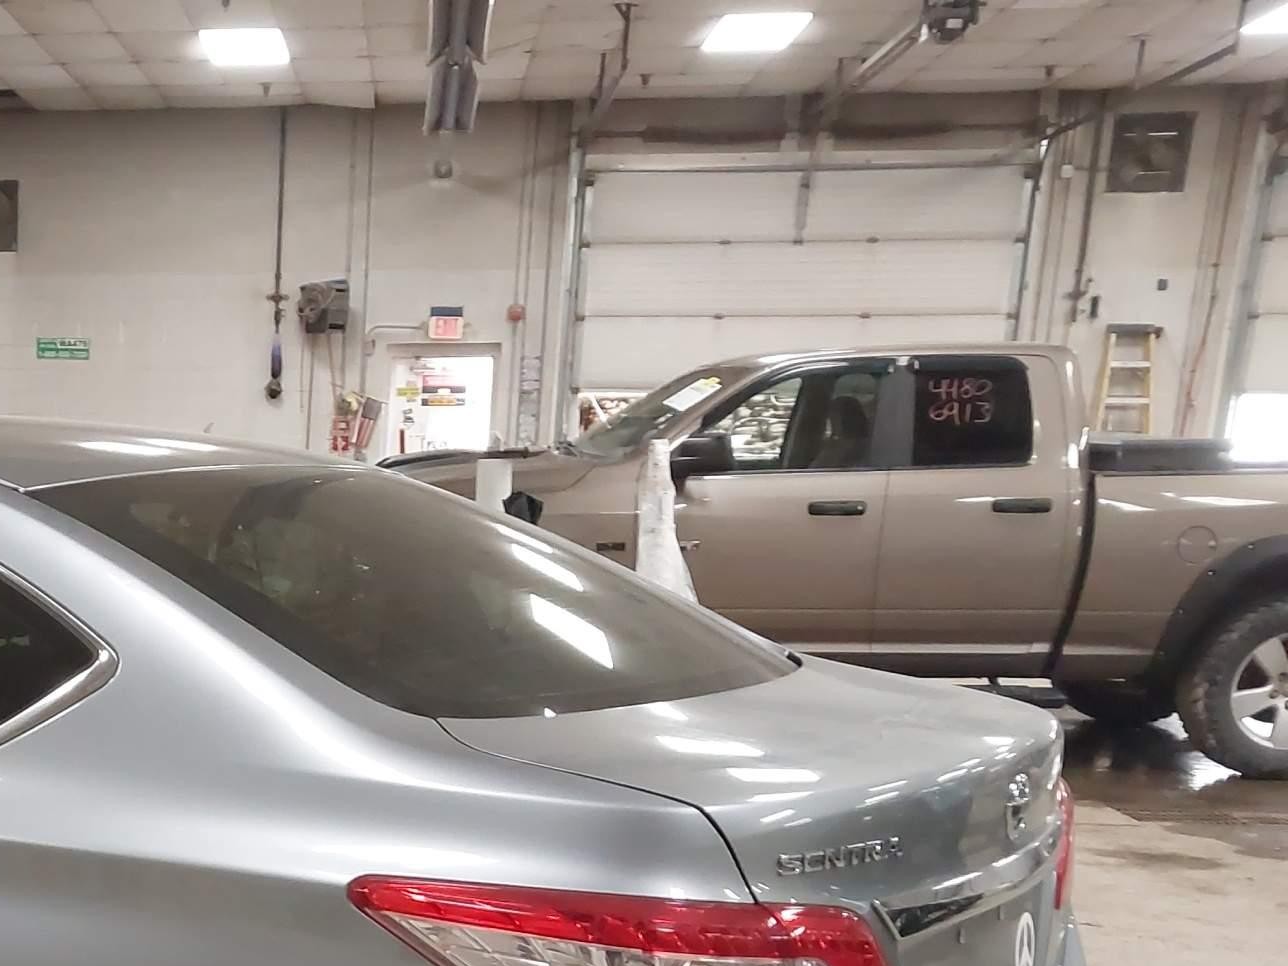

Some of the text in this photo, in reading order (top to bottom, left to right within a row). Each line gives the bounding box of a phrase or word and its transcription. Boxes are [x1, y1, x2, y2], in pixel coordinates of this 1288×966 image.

[928, 378, 993, 400] 4480
[928, 401, 992, 426] 6913
[776, 836, 903, 877] SENTRA
